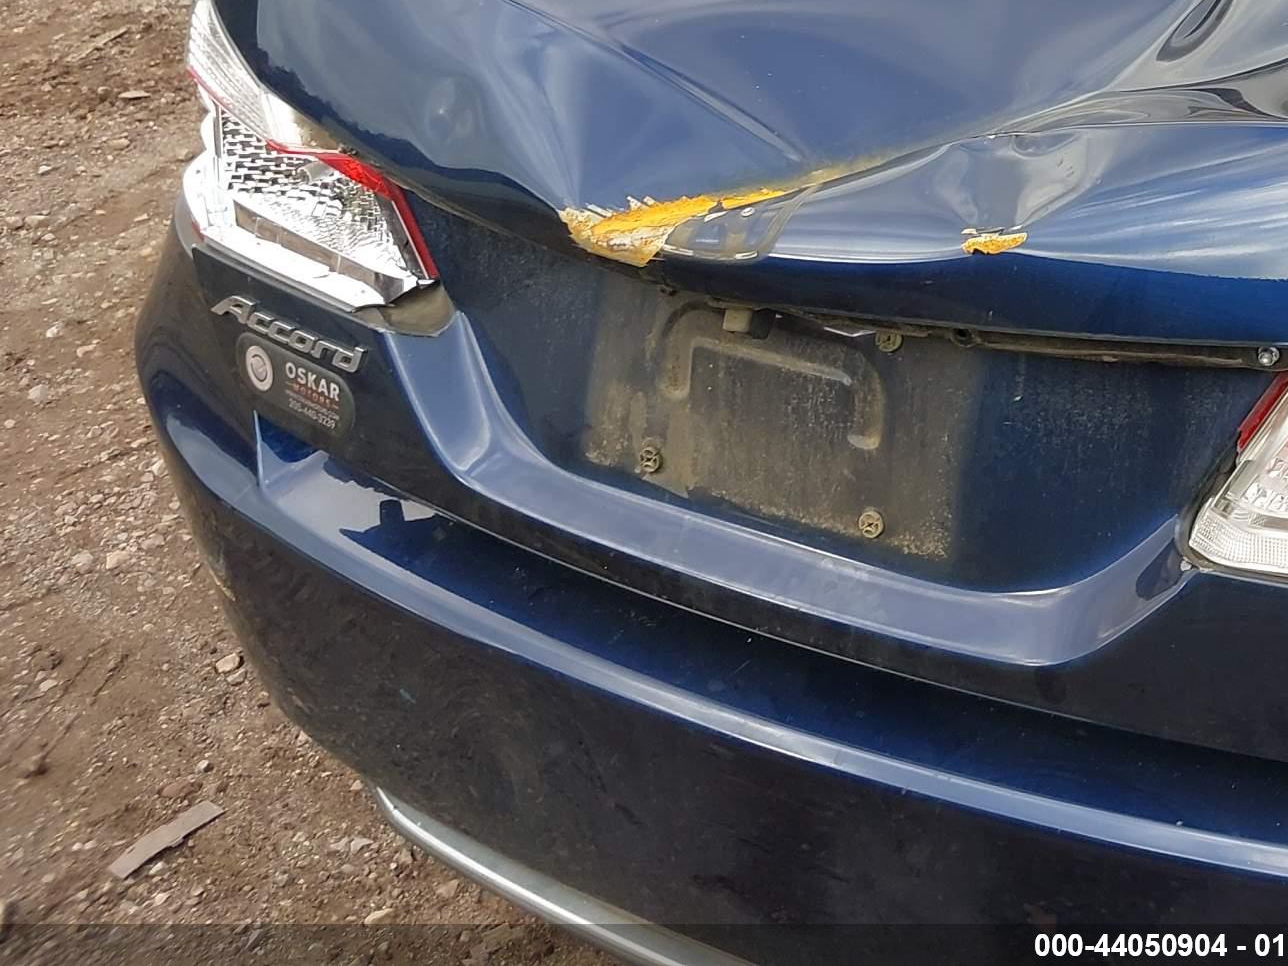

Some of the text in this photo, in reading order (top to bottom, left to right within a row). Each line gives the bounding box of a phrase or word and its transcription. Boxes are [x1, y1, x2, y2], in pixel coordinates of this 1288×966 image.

[211, 295, 368, 373] Accord
[286, 362, 340, 402] OSKAR
[293, 382, 332, 407] MOTORS
